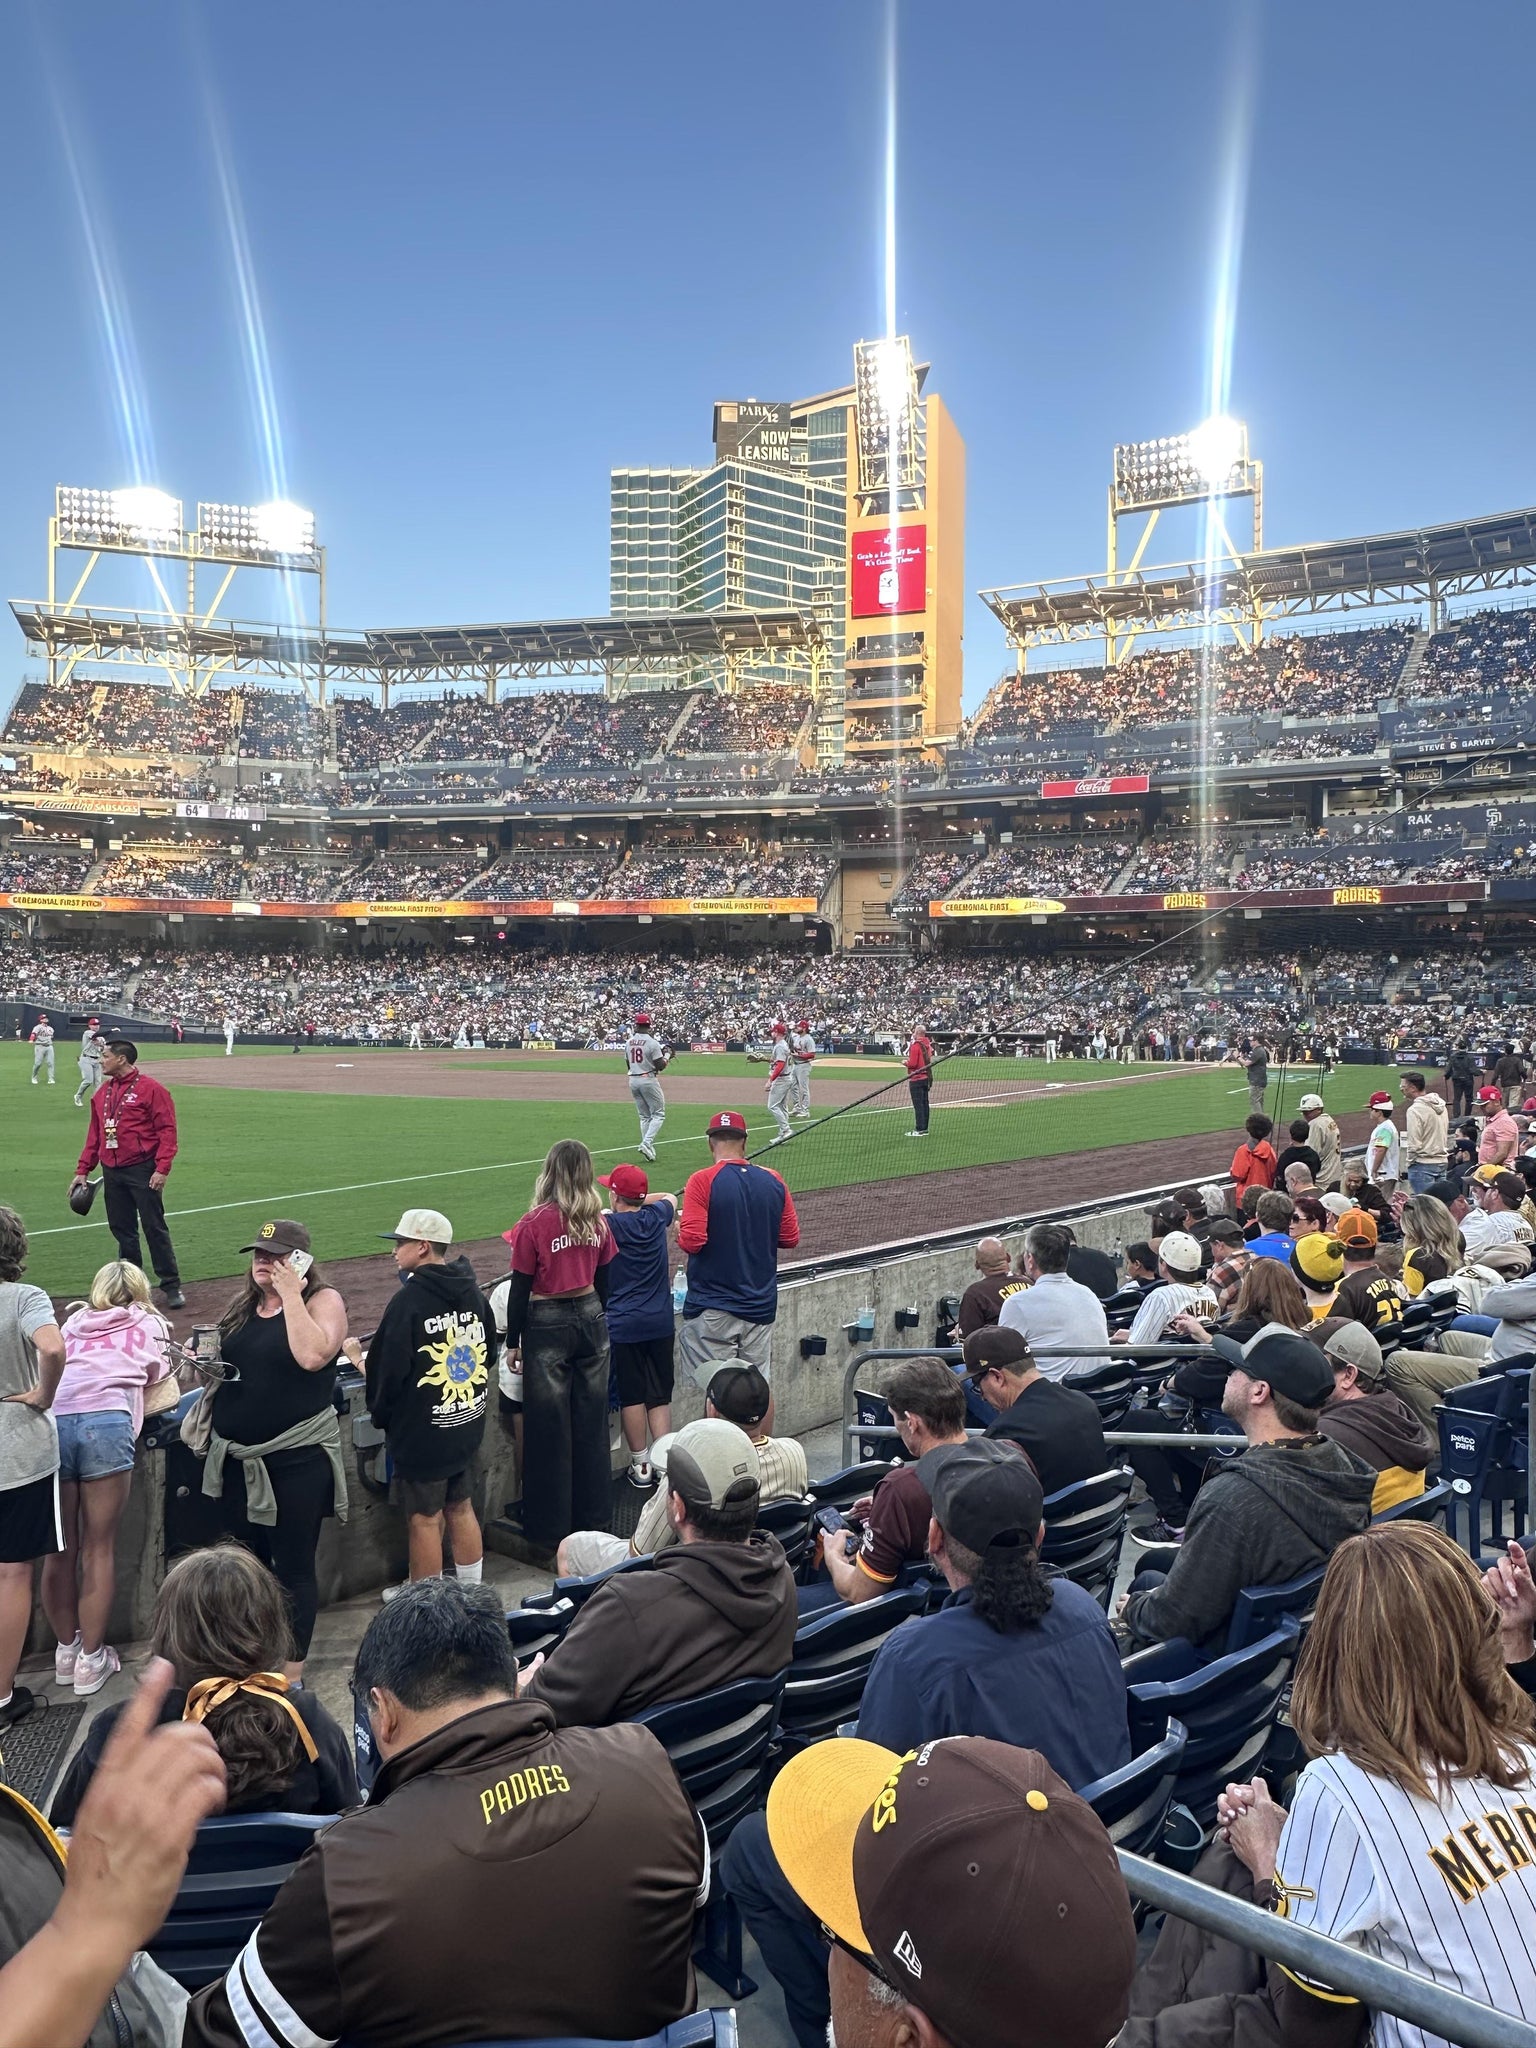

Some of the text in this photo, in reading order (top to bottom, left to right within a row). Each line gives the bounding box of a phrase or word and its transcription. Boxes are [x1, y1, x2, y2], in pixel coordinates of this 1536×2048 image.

[760, 431, 790, 446] NOW
[737, 446, 790, 461] LEASING
[880, 549, 905, 558] Leaff
[1418, 744, 1445, 752] STEVE
[1462, 738, 1496, 748] GARVEY
[1075, 780, 1113, 795] Coca-Cola
[39, 800, 138, 814] Tarantino SAUSAGES
[224, 807, 249, 820] 7:00
[1407, 814, 1433, 825] RAK
[13, 897, 102, 908] CEREMONIAL FIRST PITCH
[1163, 893, 1208, 910] PADRES
[1333, 888, 1382, 905] PADRES
[369, 905, 406, 913] CEREMONIAL
[693, 902, 774, 910] CEREMONIAL FIRST PITCH
[945, 903, 1009, 912] CEREMONIAL FIRST
[630, 1047, 644, 1064] 18
[1450, 1434, 1476, 1445] petco
[1455, 1441, 1475, 1452] park
[1458, 1482, 1465, 1491] 4
[480, 1765, 571, 1825] PADRES
